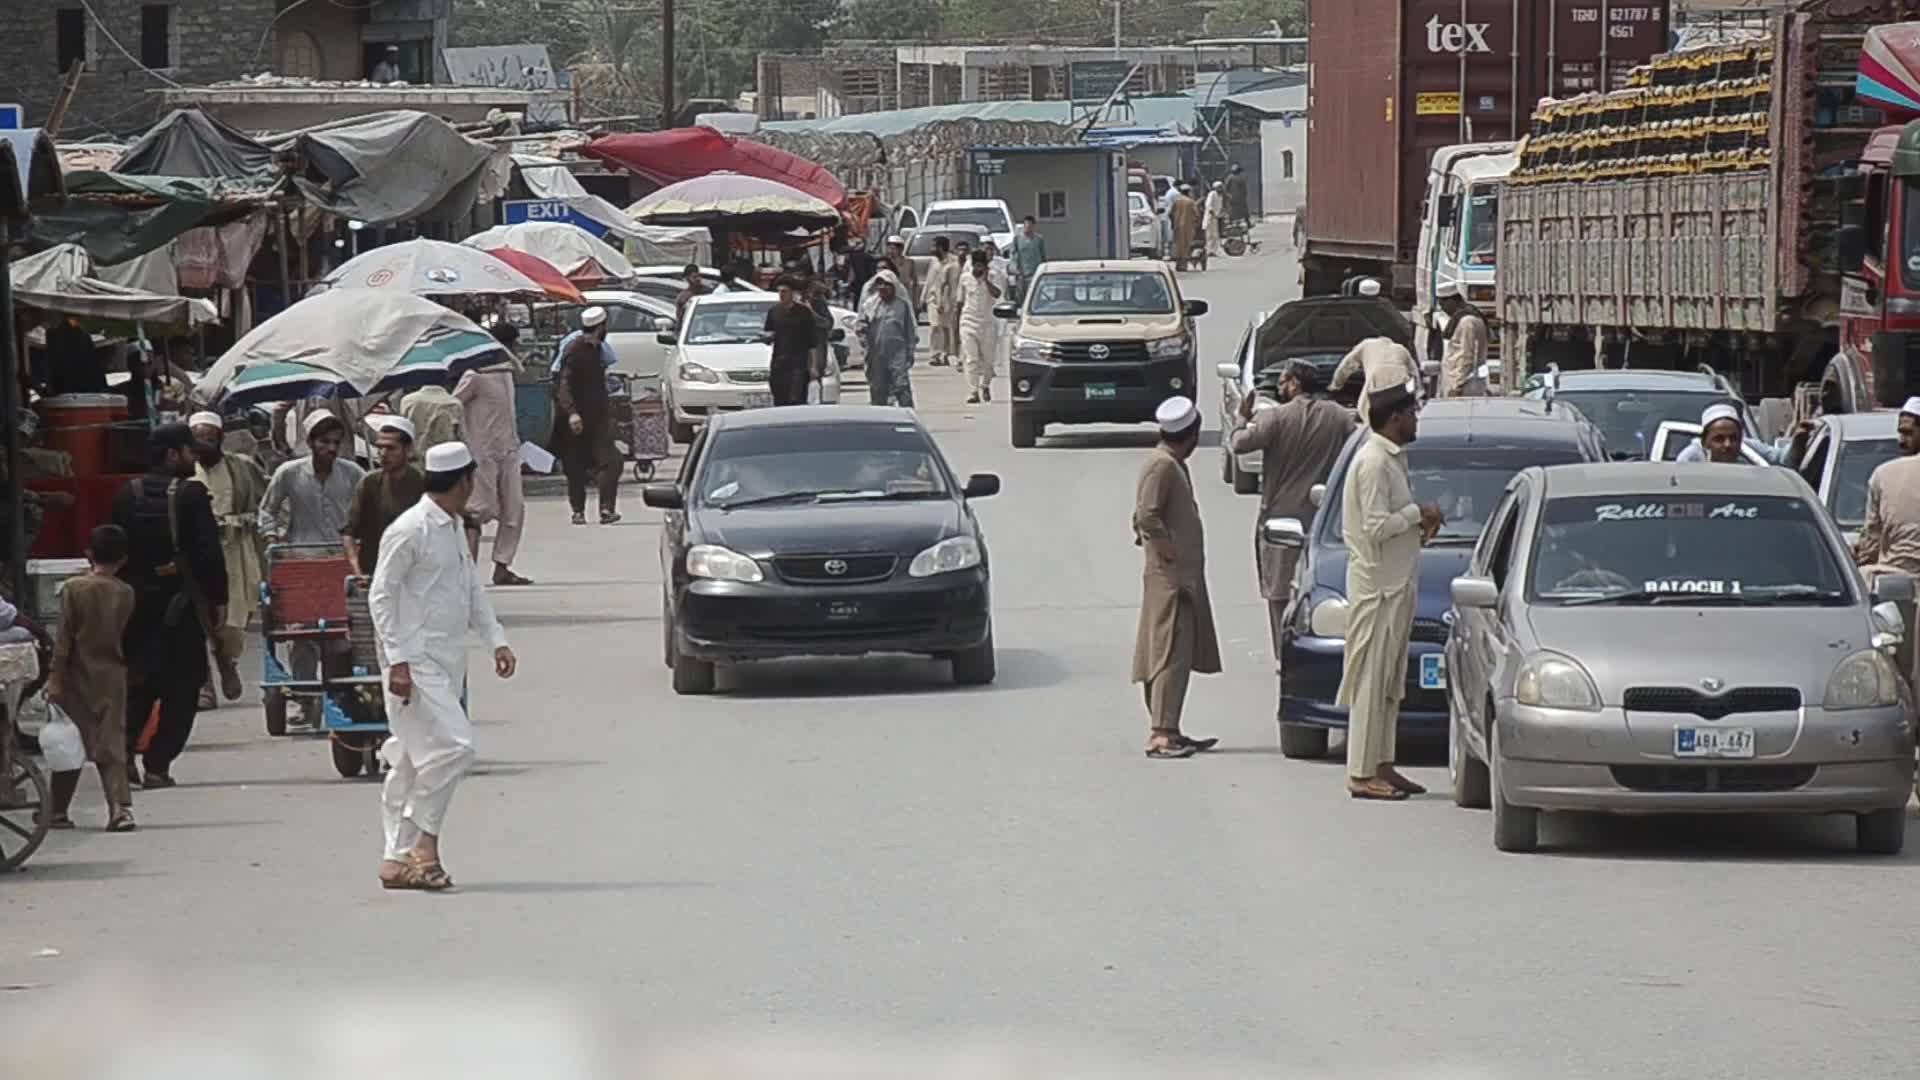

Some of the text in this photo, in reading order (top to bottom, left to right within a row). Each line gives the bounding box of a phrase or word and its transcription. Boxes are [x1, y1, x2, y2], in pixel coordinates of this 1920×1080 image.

[1425, 14, 1491, 52] tex
[527, 202, 569, 218] EXIT
[1594, 502, 1759, 523] Ralli Art
